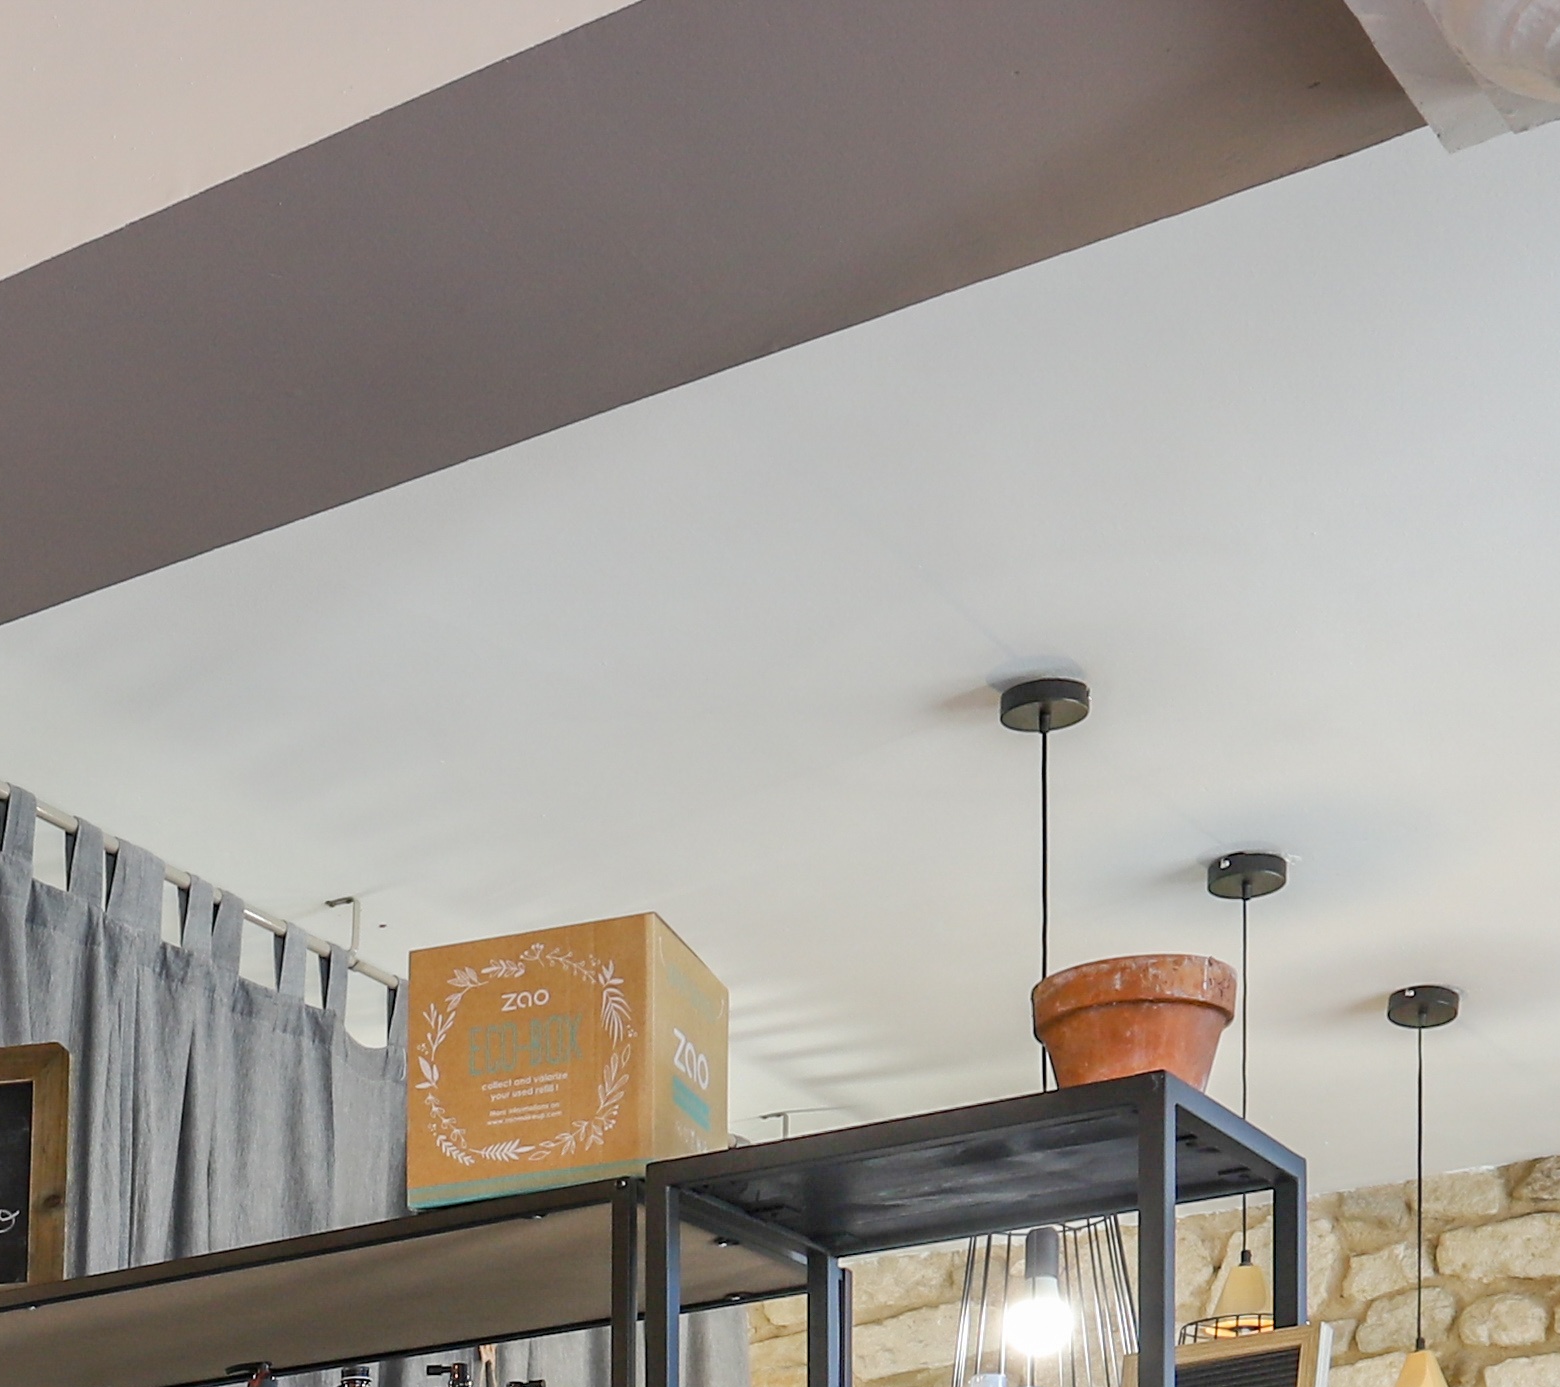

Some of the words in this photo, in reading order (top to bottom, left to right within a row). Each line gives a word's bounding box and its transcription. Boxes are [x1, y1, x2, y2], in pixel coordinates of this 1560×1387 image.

[469, 1014, 584, 1077] ECO-BOX
[481, 1079, 512, 1091] collect
[514, 1077, 532, 1086] and
[533, 1072, 568, 1083] valorize
[490, 1092, 510, 1102] your
[511, 1087, 533, 1097] used
